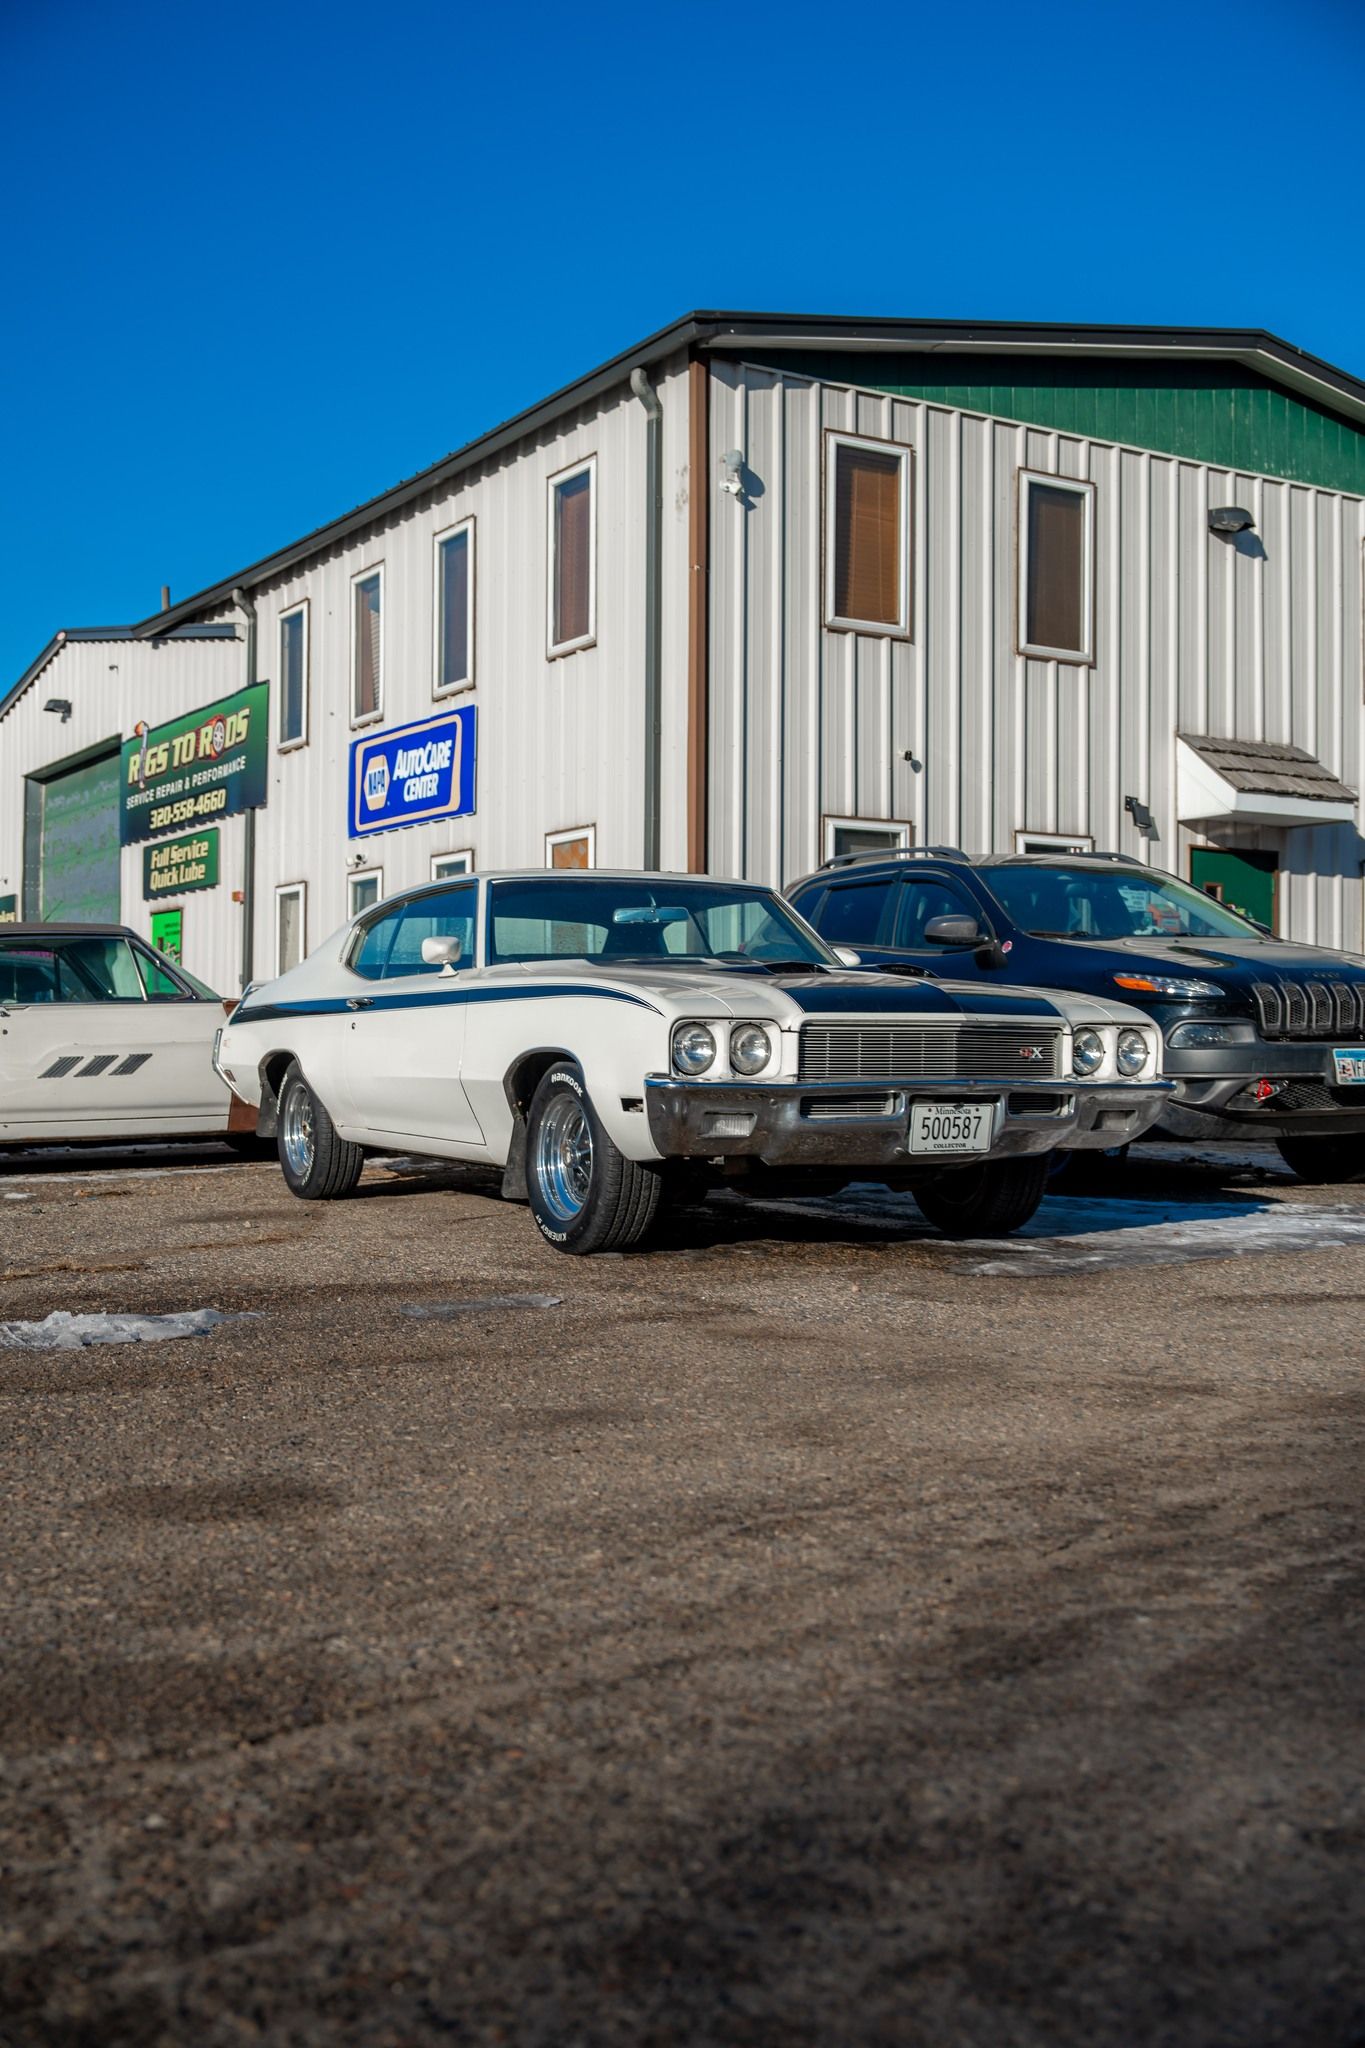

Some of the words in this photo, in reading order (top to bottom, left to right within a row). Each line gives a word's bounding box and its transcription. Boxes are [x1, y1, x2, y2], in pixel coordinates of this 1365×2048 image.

[172, 731, 197, 768] TO
[198, 708, 250, 759] RODS
[126, 788, 155, 810] SERVICE
[155, 779, 184, 799] REPAIR
[184, 777, 191, 790] &
[192, 755, 246, 787] PERFORMANCE
[367, 768, 386, 796] NAPA
[403, 772, 440, 803] CENTER
[149, 788, 226, 830] 320-558-4660
[150, 847, 170, 870] Full
[170, 839, 209, 866] Service
[149, 866, 179, 891] Quick
[179, 861, 206, 884] Lube
[921, 1116, 982, 1140] 500587
